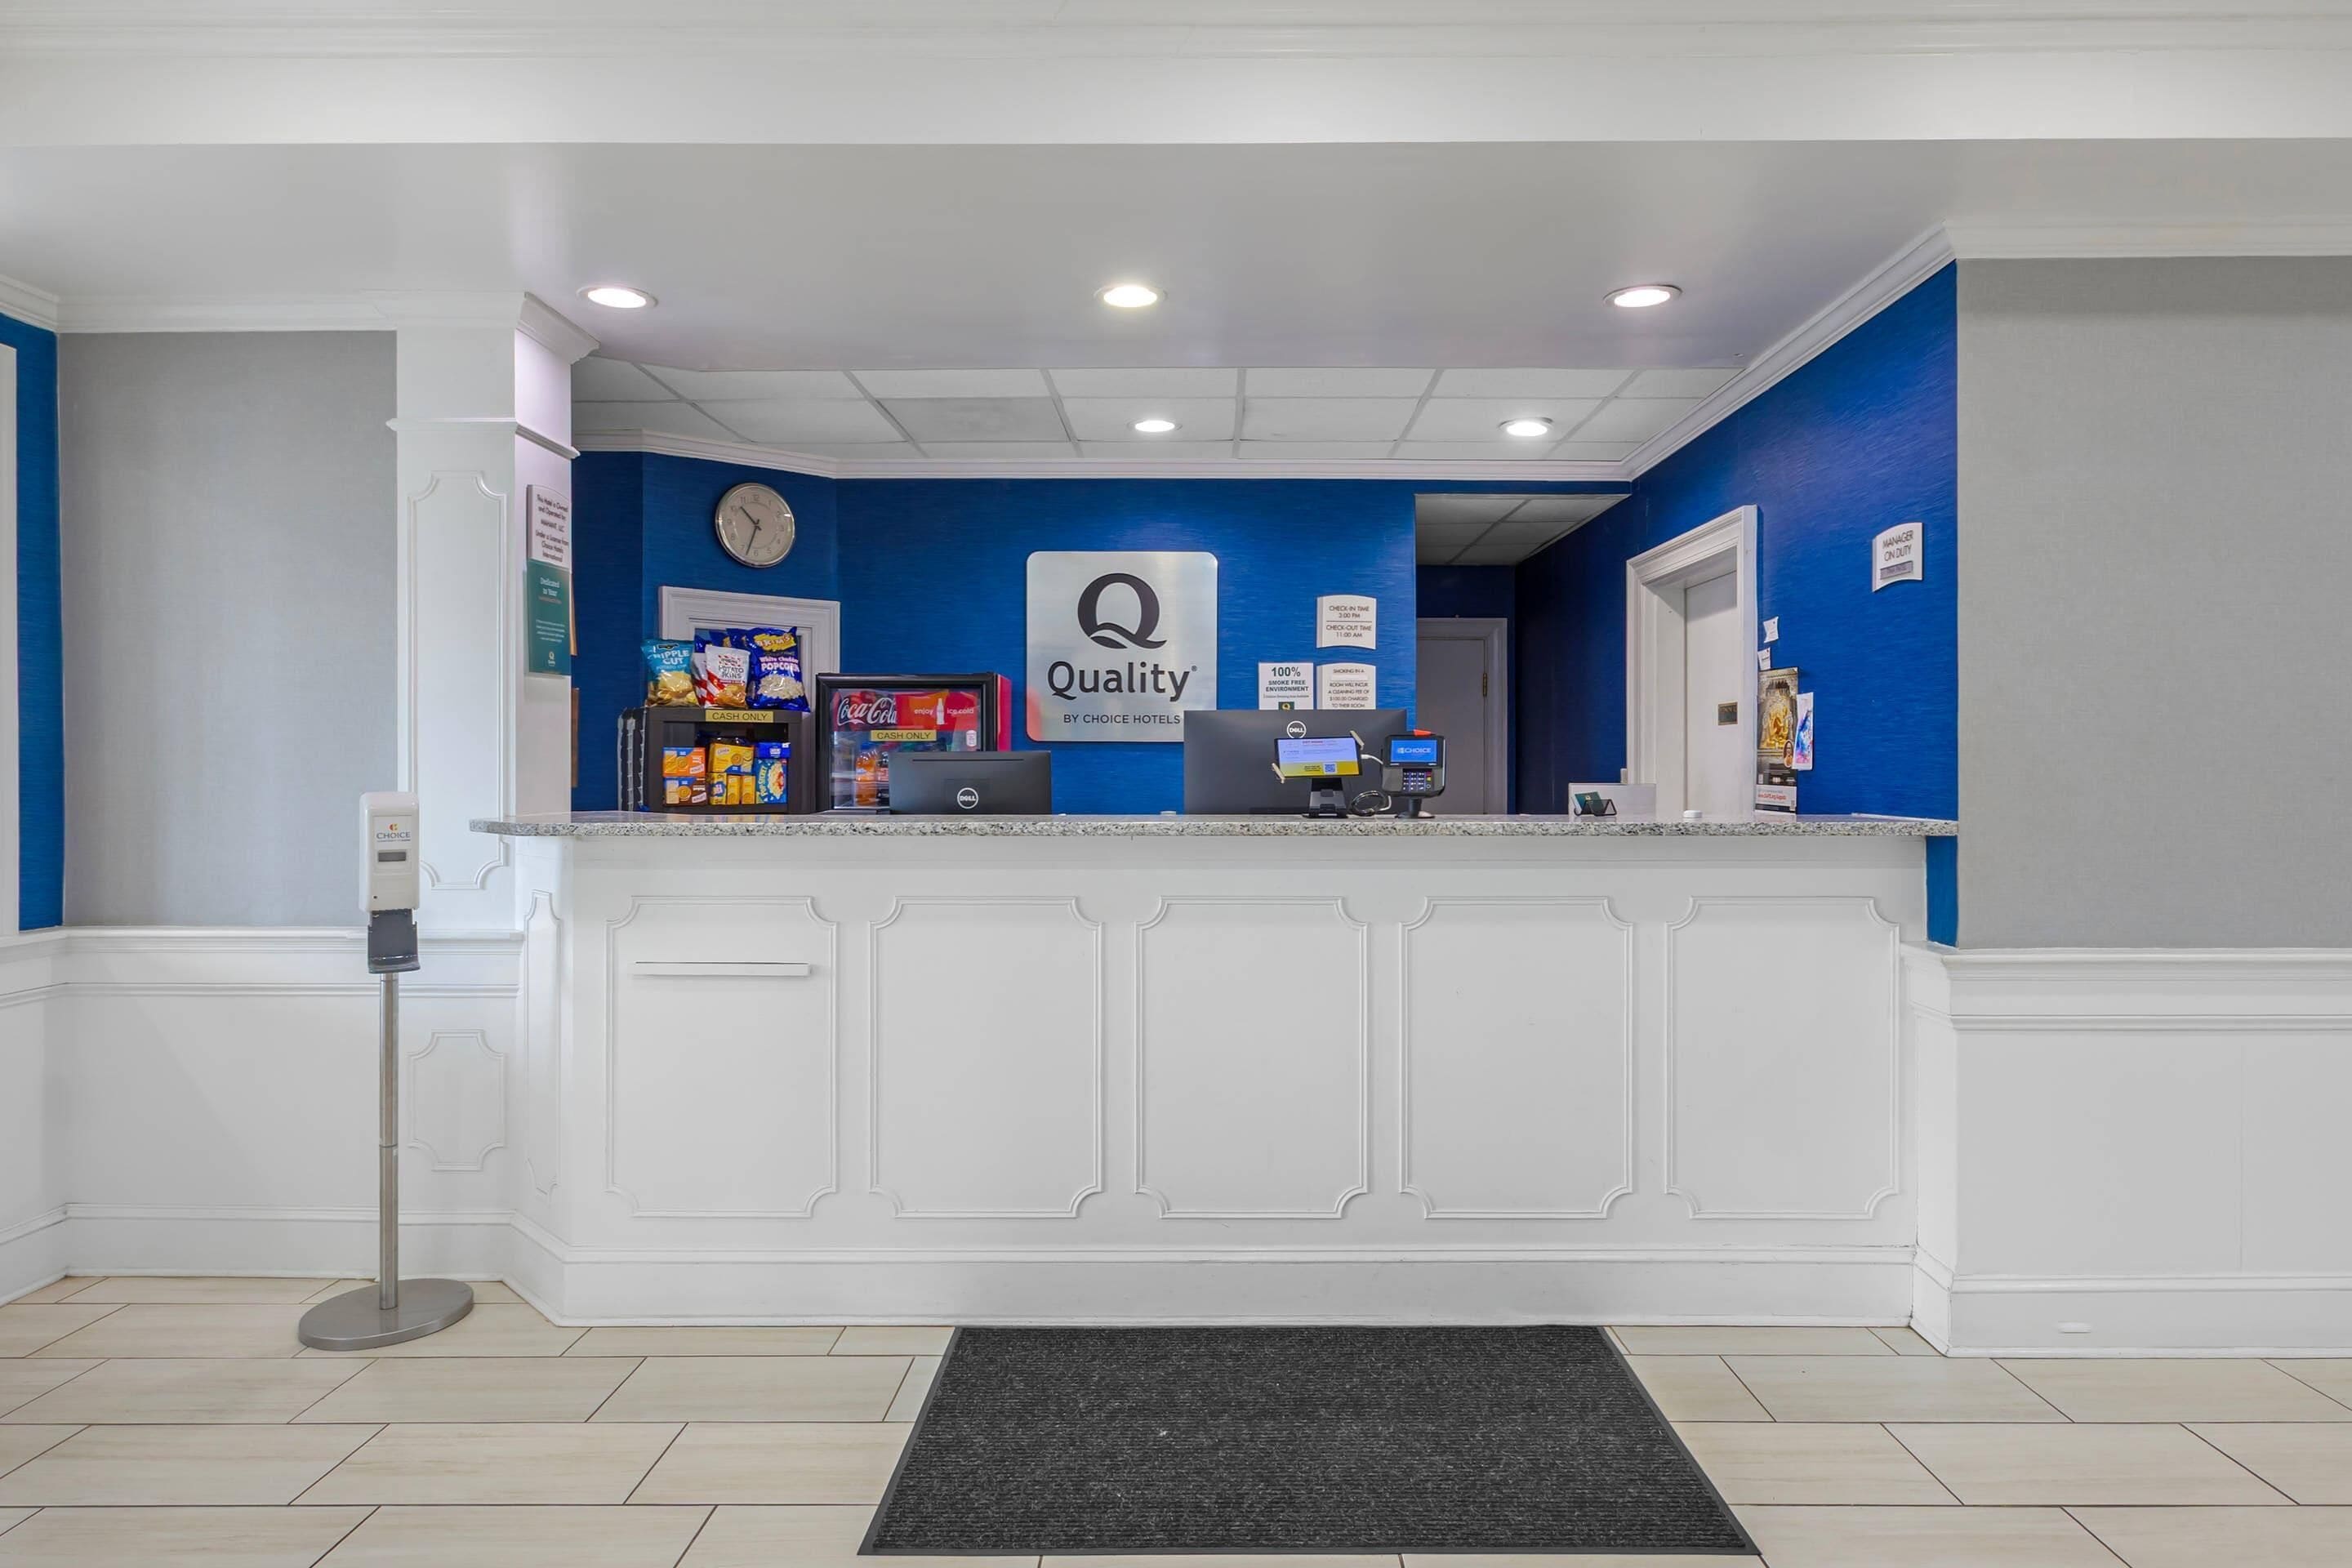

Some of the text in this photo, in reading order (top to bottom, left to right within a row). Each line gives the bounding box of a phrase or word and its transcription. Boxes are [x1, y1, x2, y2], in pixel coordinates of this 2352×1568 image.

[1882, 529, 1914, 549] MANAGER
[1883, 543, 1912, 562] ON DUTY
[662, 657, 684, 666] CUT
[1271, 666, 1301, 677] 100%
[711, 711, 768, 721] CASH ONLY
[836, 697, 898, 727] Coca-Cola
[914, 707, 934, 715] enjoy
[1063, 714, 1181, 724] BY CHOICE HOTELS
[876, 732, 931, 740] CASH ONLY
